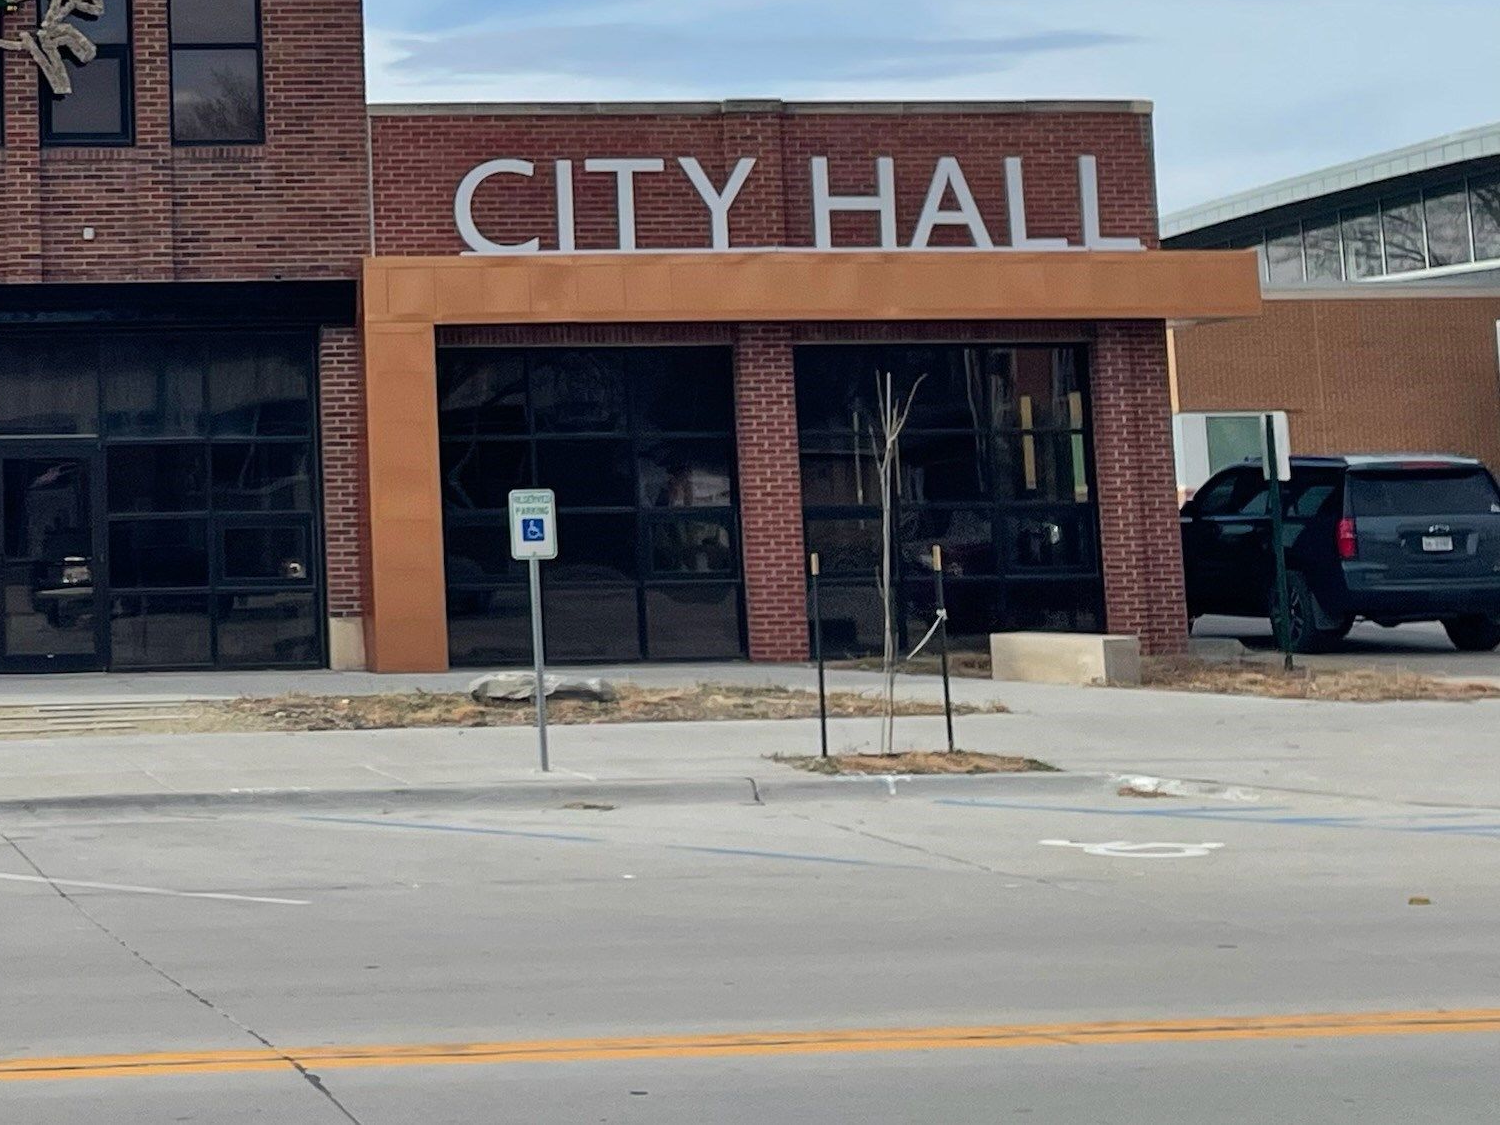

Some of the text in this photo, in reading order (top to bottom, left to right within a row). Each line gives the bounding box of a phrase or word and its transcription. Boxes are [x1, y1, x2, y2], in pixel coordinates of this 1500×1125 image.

[454, 154, 1146, 252] CITY HALL
[511, 494, 553, 504] RESERVED
[515, 506, 550, 515] PARKING
